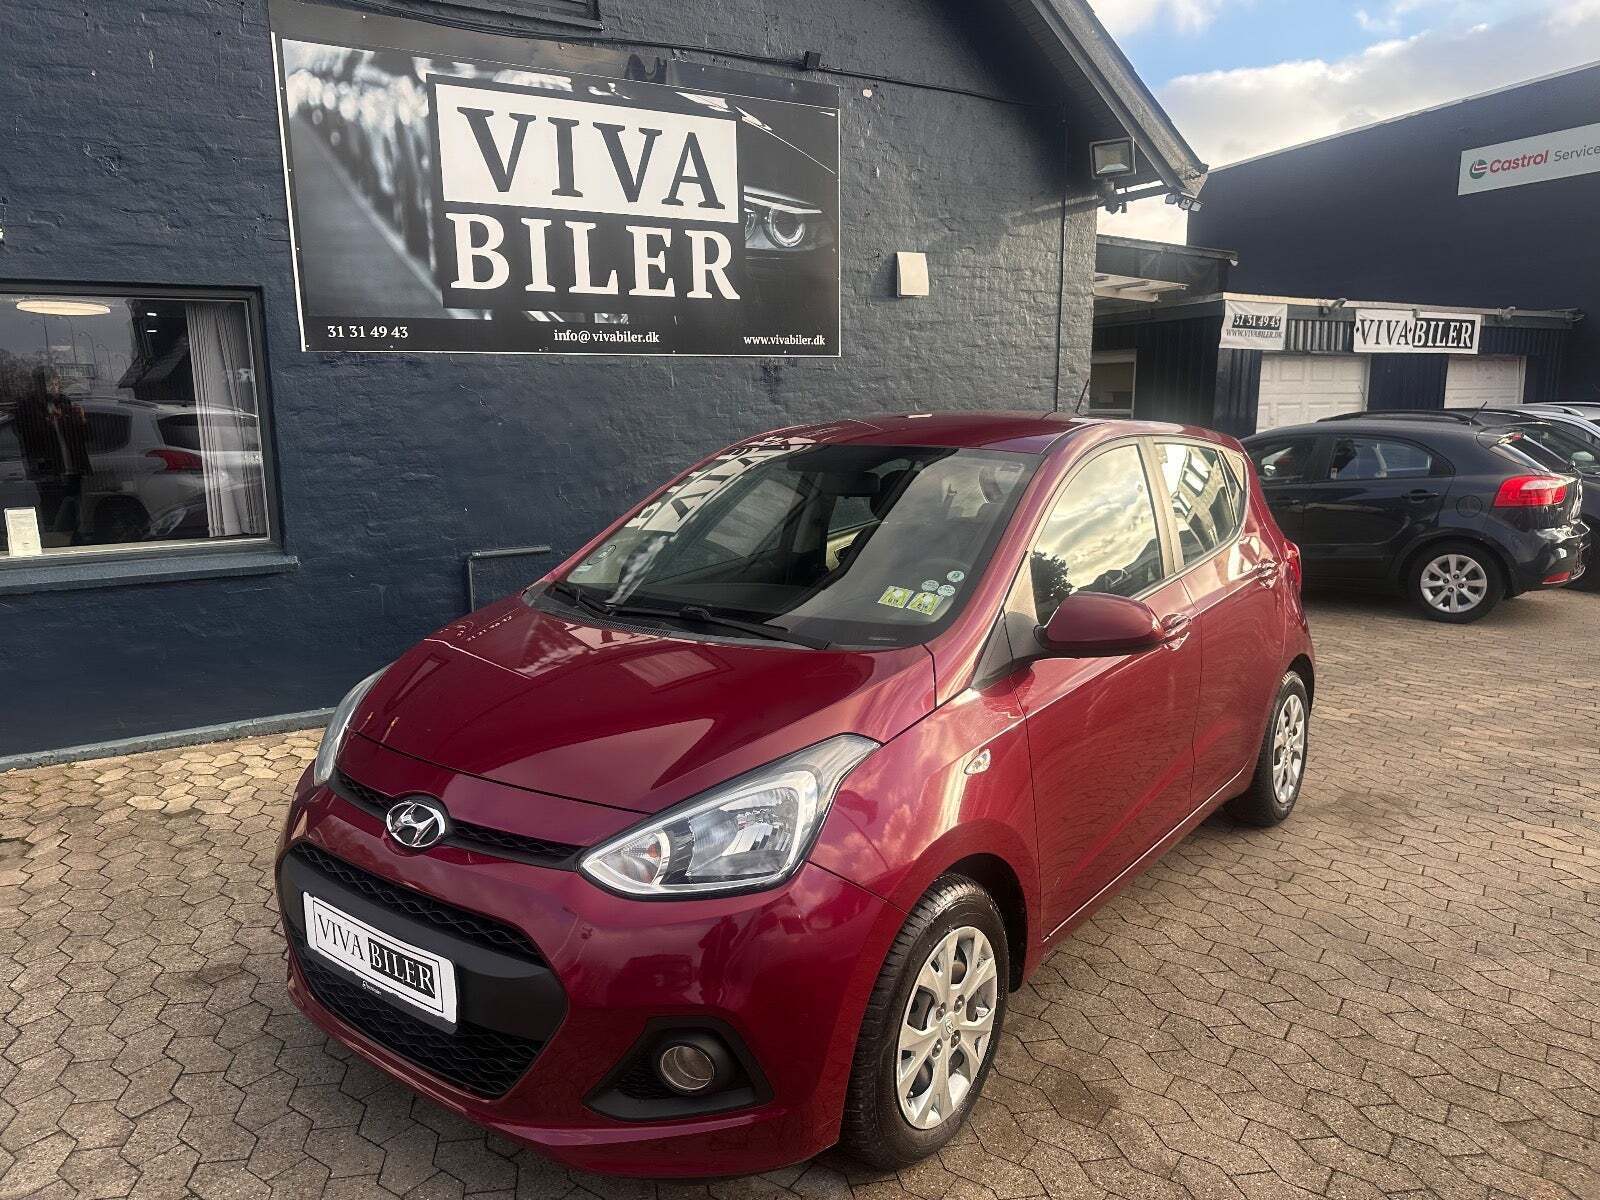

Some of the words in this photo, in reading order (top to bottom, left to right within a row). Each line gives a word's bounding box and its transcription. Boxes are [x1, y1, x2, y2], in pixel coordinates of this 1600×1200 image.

[457, 106, 726, 210] VIVA
[1489, 150, 1549, 173] Castrol
[1553, 144, 1600, 162] Service
[445, 212, 741, 300] BILER
[327, 325, 345, 338] 31
[349, 325, 366, 338] 31
[369, 325, 388, 338] 49
[390, 326, 409, 339] 43
[1234, 314, 1245, 326] 31
[1246, 315, 1256, 327] 31
[1258, 315, 1269, 327] 49
[1270, 316, 1280, 328] 43
[1360, 319, 1410, 345] VIVA
[1413, 319, 1473, 347] BILER
[553, 329, 660, 343] info@vivabiler.dk
[743, 334, 826, 346] www.vivabiler.dk
[317, 913, 366, 962] VIVA
[369, 941, 435, 995] BILER
